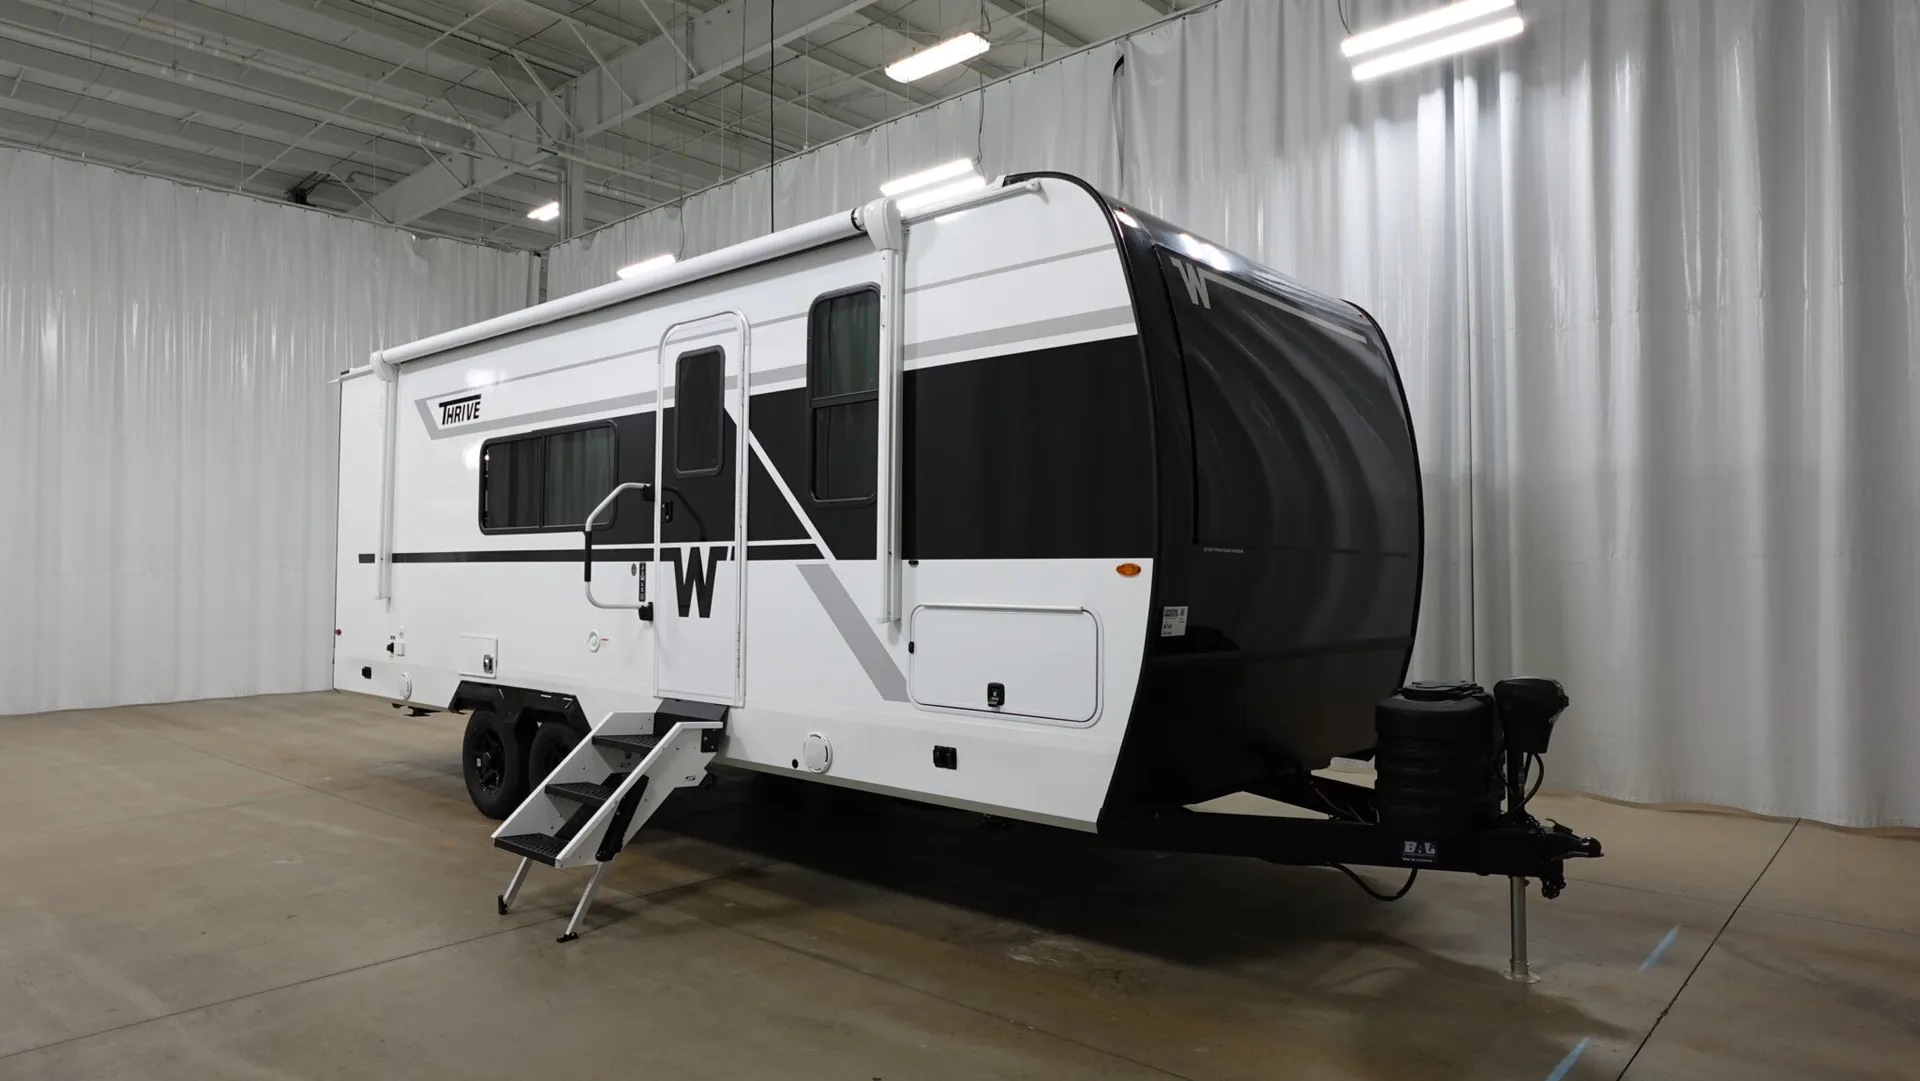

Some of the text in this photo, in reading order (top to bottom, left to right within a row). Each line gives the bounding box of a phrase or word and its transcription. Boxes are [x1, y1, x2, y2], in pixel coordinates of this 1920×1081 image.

[1169, 256, 1212, 310] W
[439, 393, 481, 425] THRIVE
[667, 546, 728, 618] W
[1404, 841, 1435, 854] BAL
